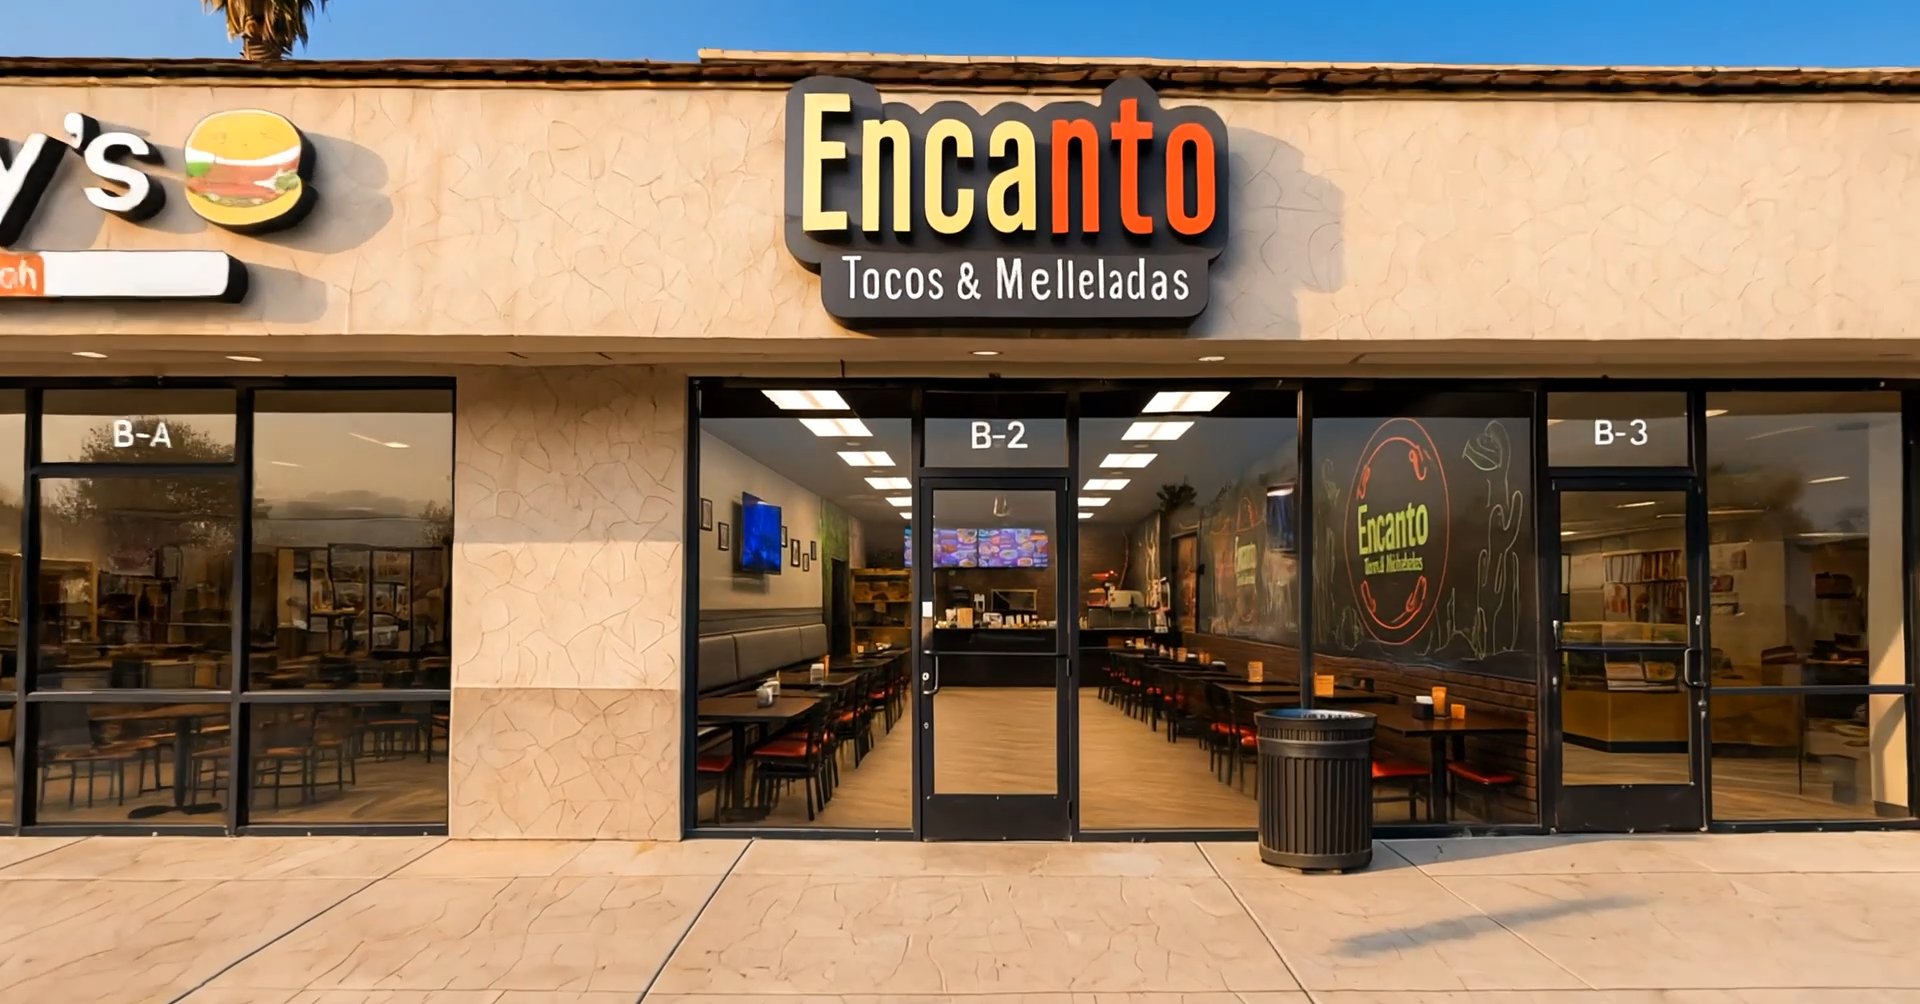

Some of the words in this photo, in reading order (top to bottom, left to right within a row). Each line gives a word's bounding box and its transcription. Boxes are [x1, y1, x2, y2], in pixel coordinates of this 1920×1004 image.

[802, 93, 1216, 235] Encanto
[841, 255, 944, 300] Tocos
[956, 261, 982, 300] &
[996, 257, 1190, 301] Melleladas
[111, 418, 172, 448] B-A
[971, 420, 1029, 449] B-2
[1594, 419, 1649, 446] B-3
[1357, 502, 1429, 556] Encanto
